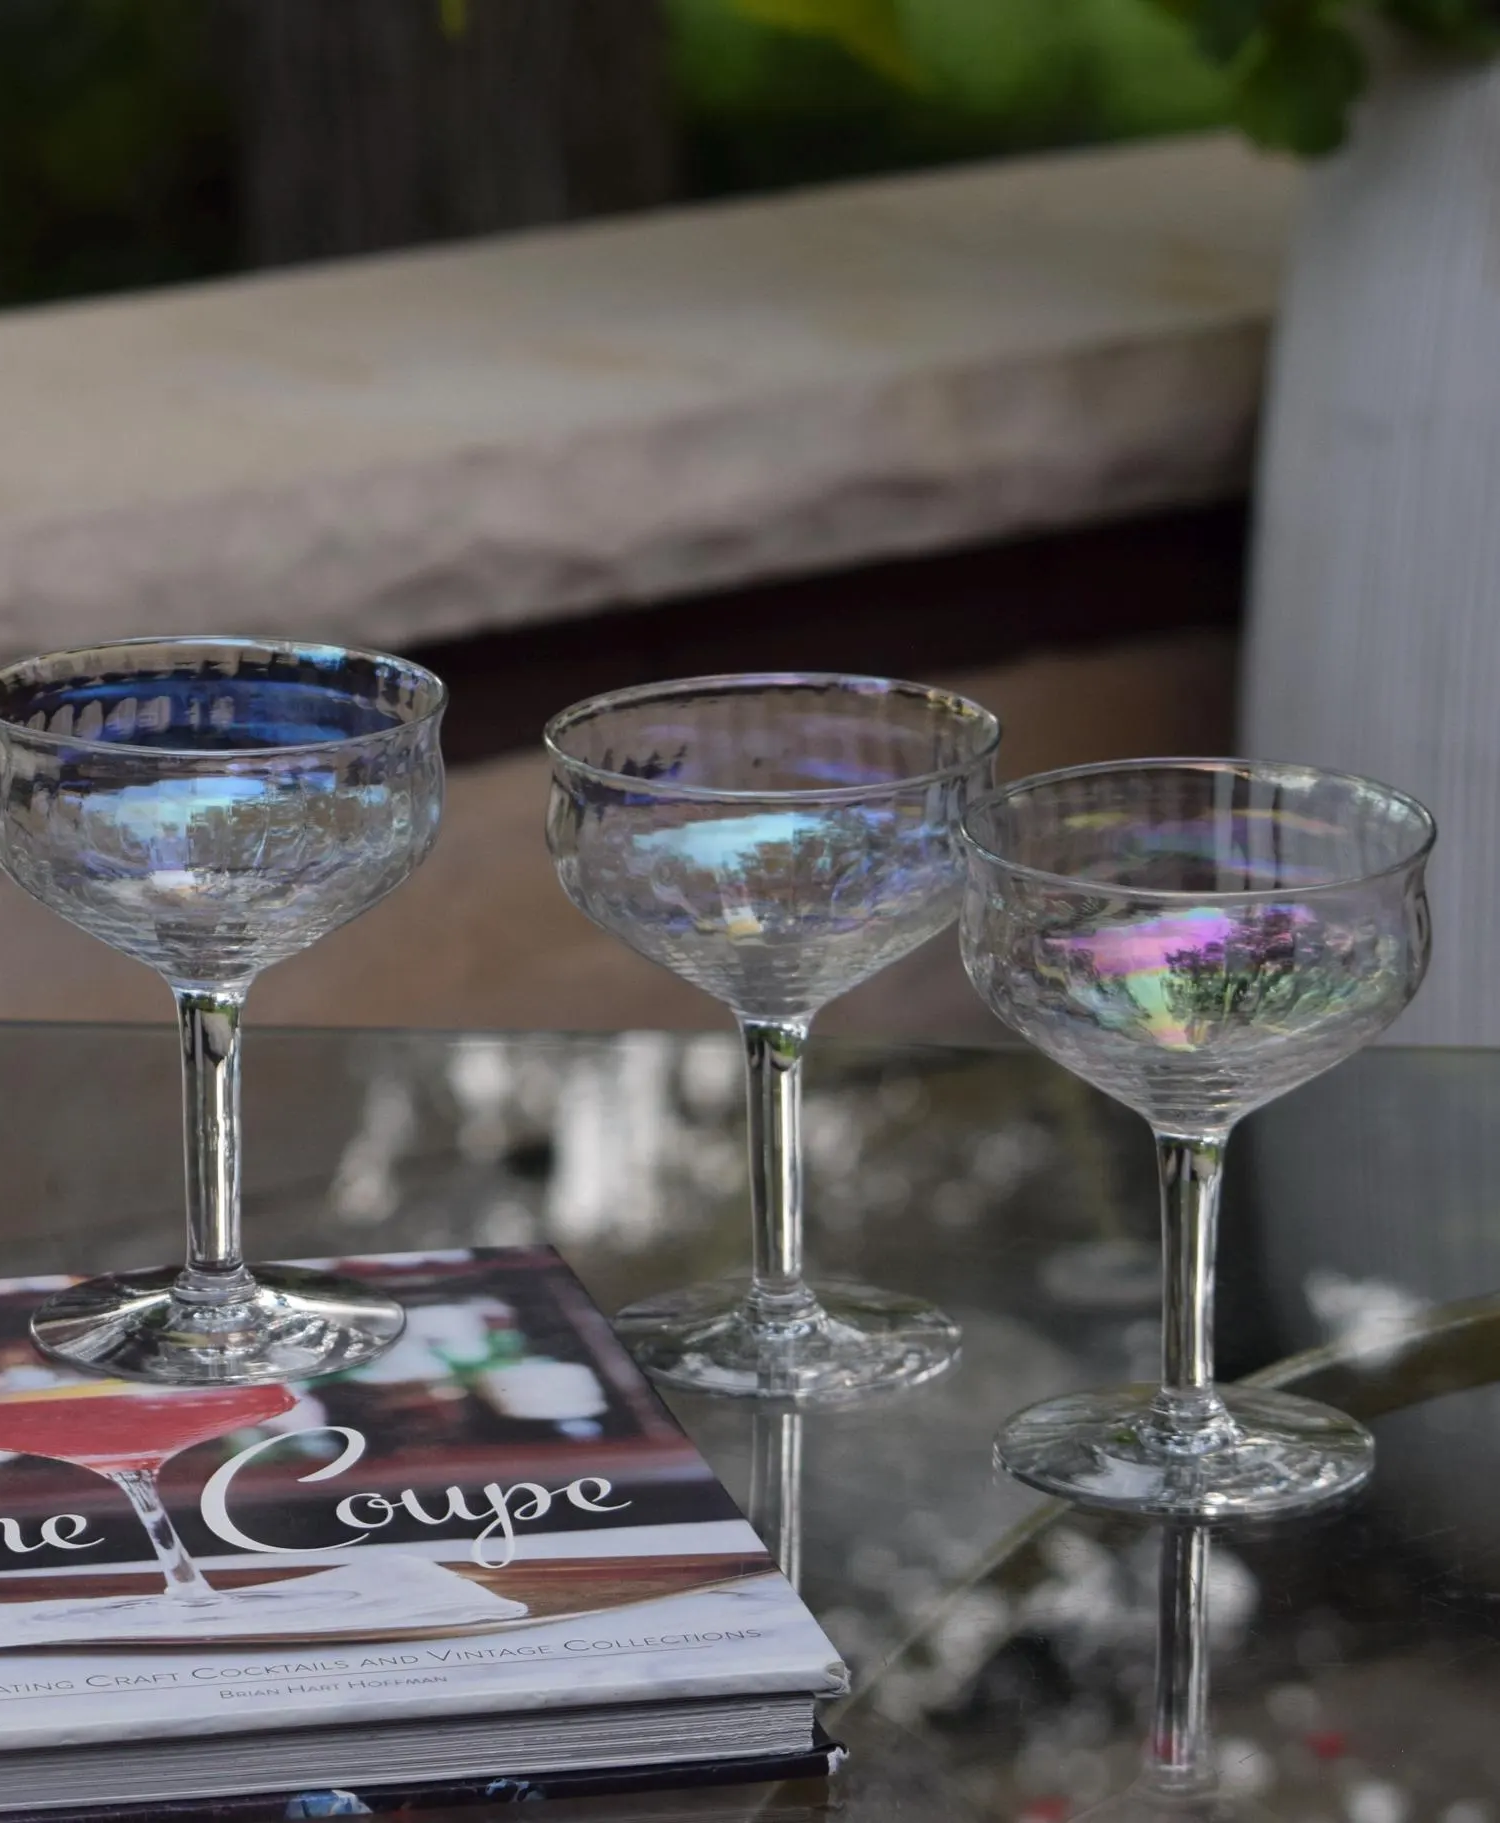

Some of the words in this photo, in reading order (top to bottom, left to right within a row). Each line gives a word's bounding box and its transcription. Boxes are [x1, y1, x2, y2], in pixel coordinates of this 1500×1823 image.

[199, 1425, 634, 1569] Coupe
[85, 1672, 180, 1688] CRAFT
[191, 1660, 350, 1680] COCKTAILS
[360, 1655, 420, 1668] AND
[426, 1645, 555, 1663] VINTAGE
[563, 1629, 763, 1652] COLLECTIONS
